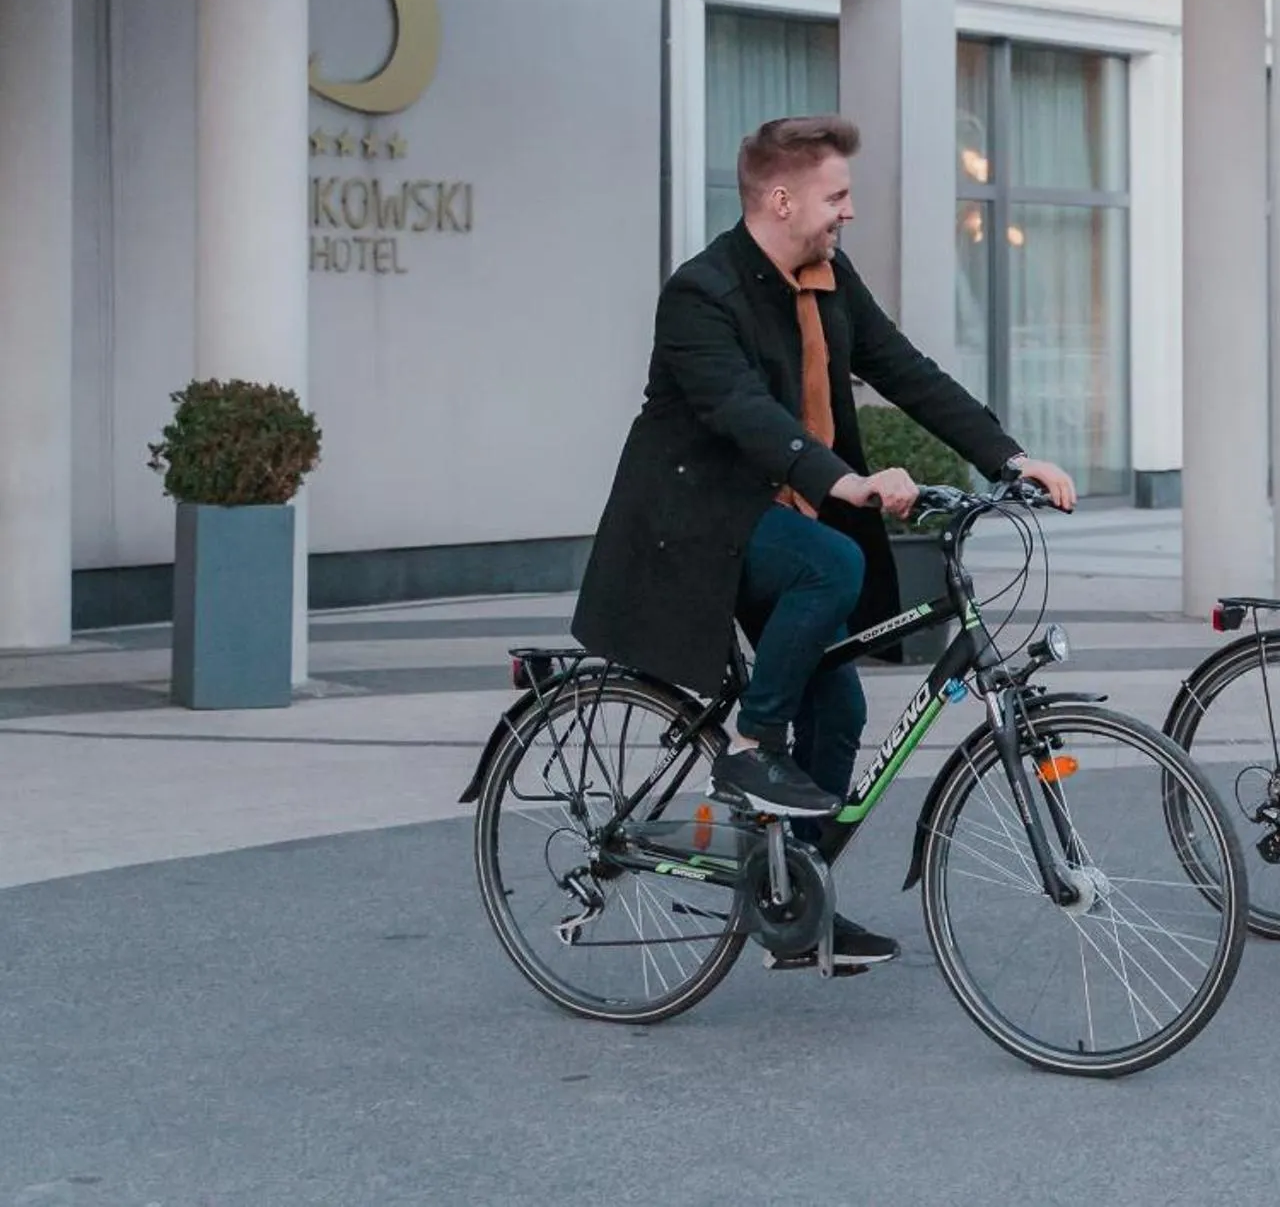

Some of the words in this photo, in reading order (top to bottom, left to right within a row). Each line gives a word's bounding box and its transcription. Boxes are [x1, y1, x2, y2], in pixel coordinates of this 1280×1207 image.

[309, 176, 474, 233] KOWSKI
[309, 235, 409, 274] HOTEL
[856, 681, 931, 799] SAVENO
